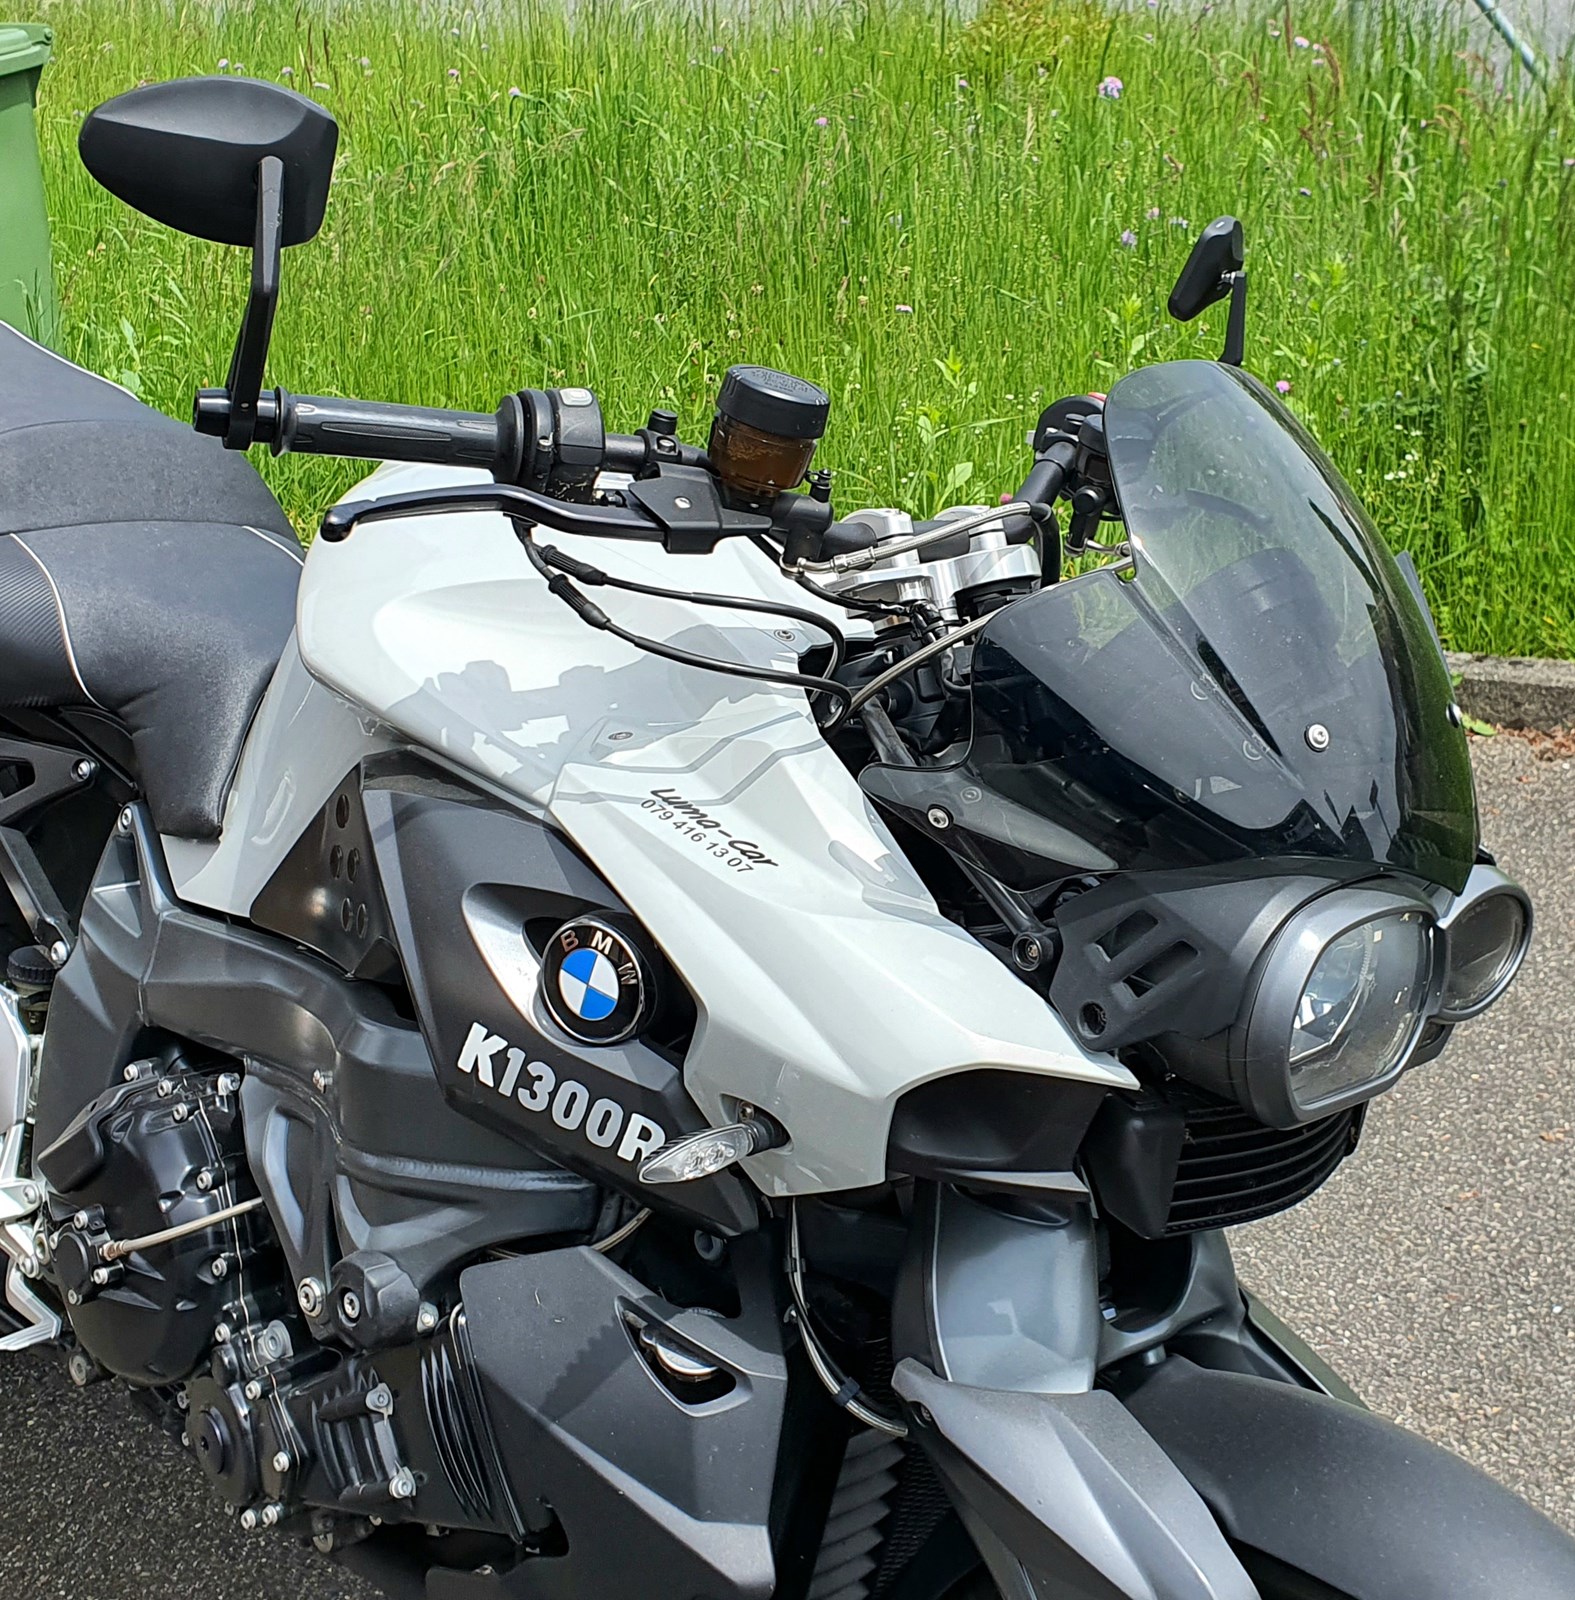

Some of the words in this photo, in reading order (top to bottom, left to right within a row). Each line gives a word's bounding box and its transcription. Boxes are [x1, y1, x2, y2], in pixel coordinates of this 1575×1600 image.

[641, 800, 674, 821] 079
[673, 821, 706, 842] 416
[706, 842, 729, 858] 13
[727, 857, 754, 872] 07
[560, 930, 638, 985] BMW
[457, 1021, 666, 1162] K1300R
